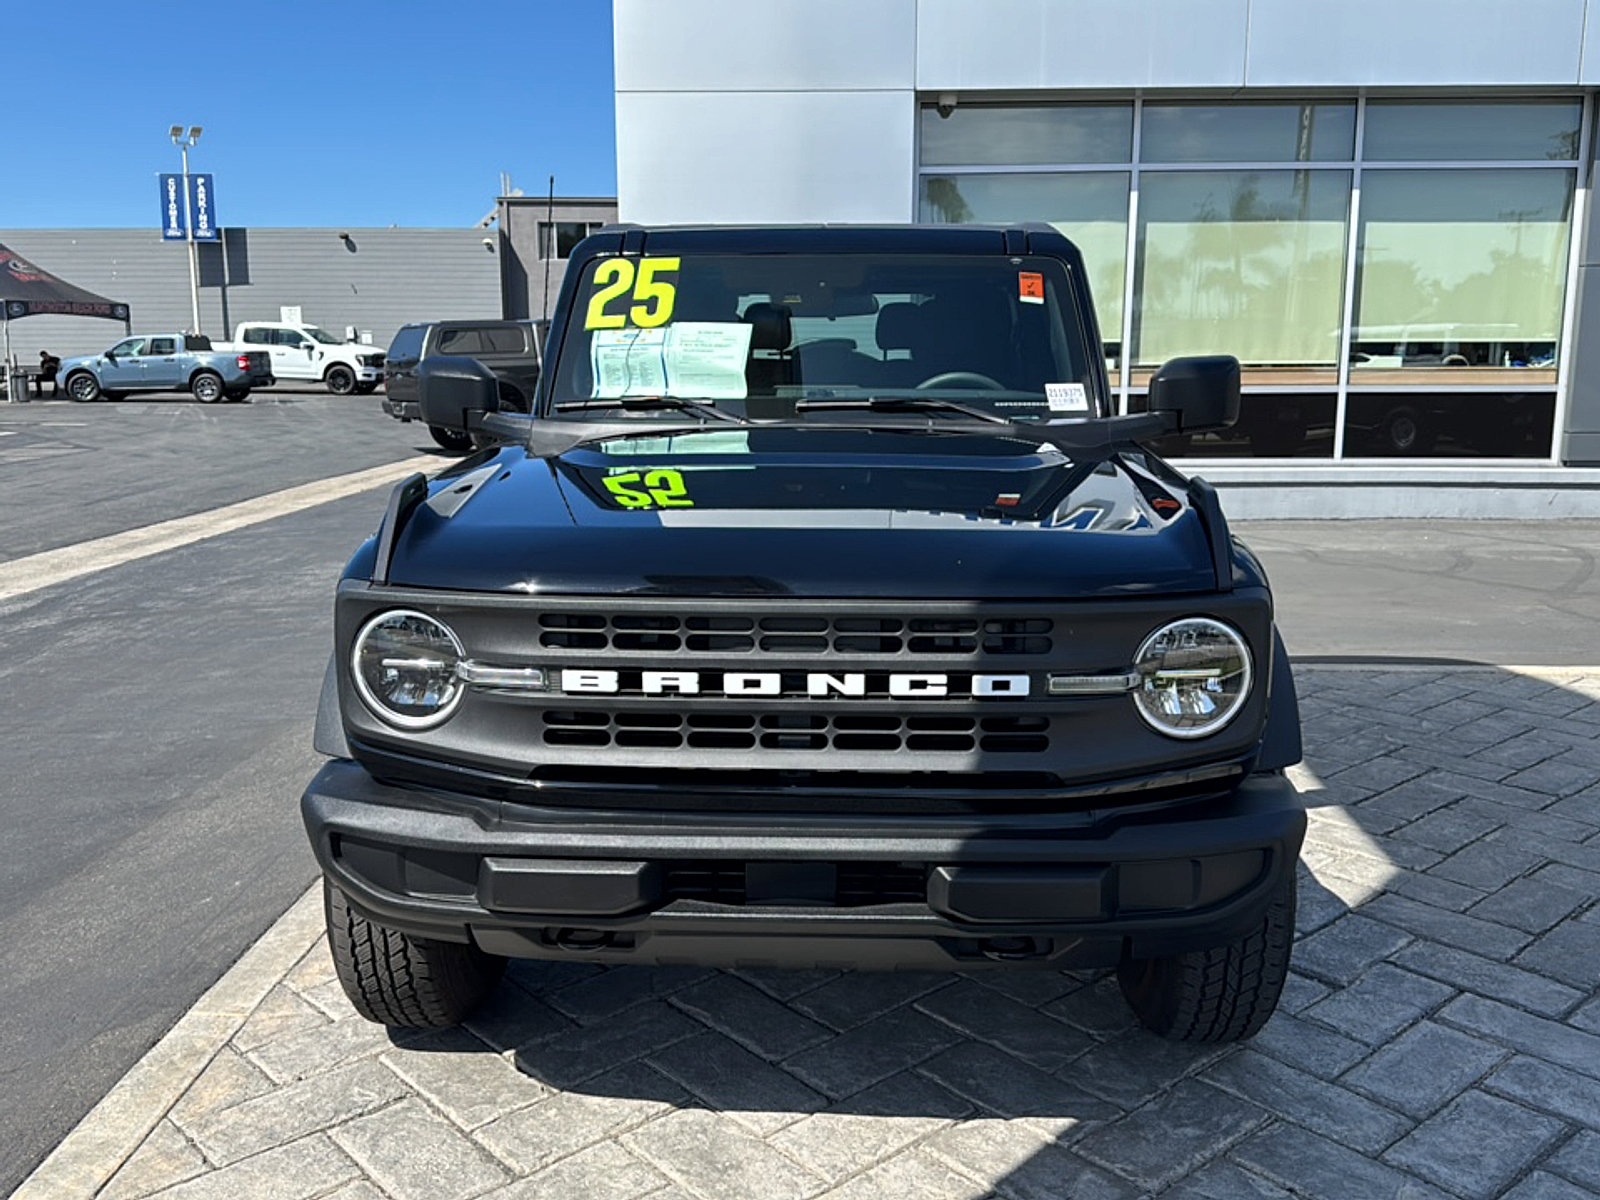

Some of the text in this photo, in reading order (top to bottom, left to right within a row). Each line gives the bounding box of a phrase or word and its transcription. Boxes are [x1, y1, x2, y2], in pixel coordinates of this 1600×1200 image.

[196, 177, 208, 229] PARKING
[585, 257, 681, 330] 25
[561, 669, 1031, 697] BRONCO
